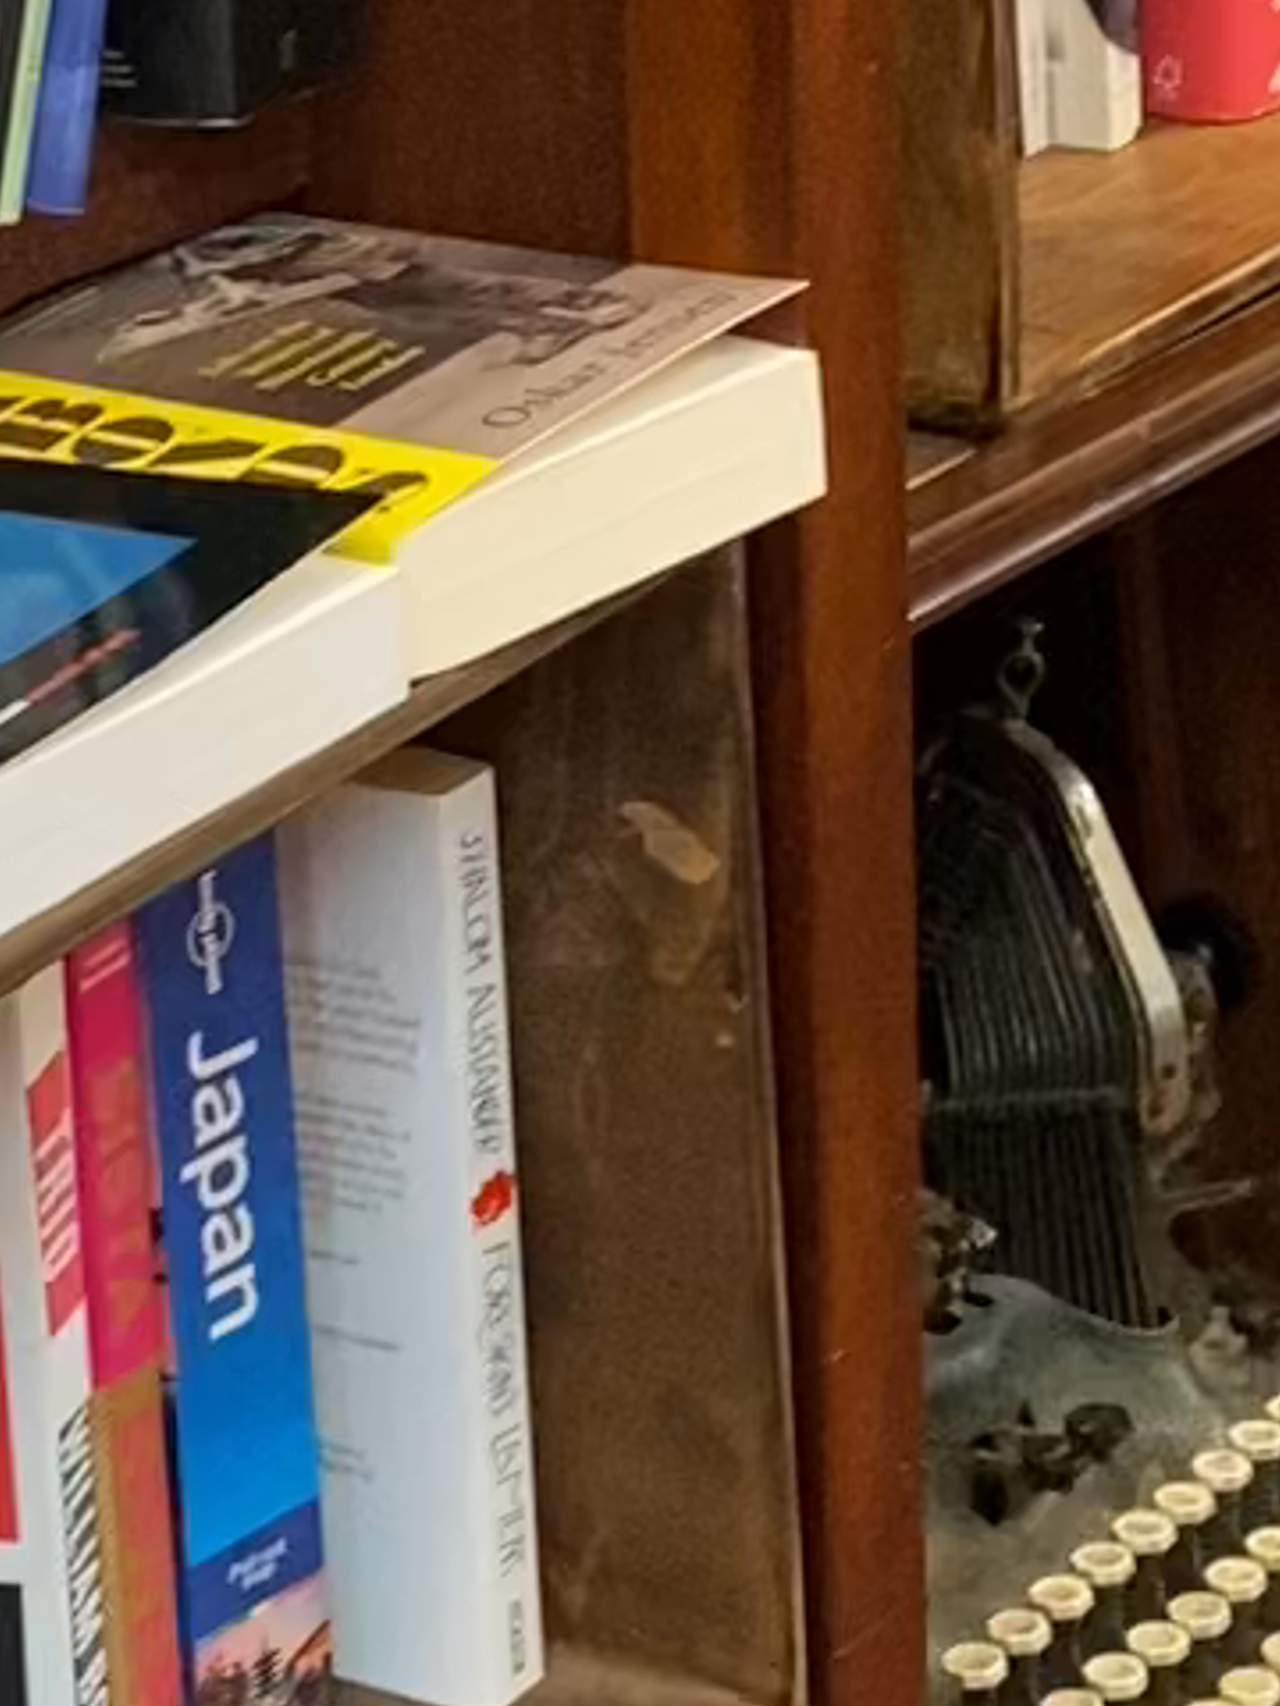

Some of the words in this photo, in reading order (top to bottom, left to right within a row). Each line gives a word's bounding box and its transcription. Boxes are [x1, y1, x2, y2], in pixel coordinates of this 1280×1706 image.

[455, 827, 494, 976] SHALOM
[178, 1029, 261, 1343] Japan
[58, 1400, 105, 1662] WILLIAM
